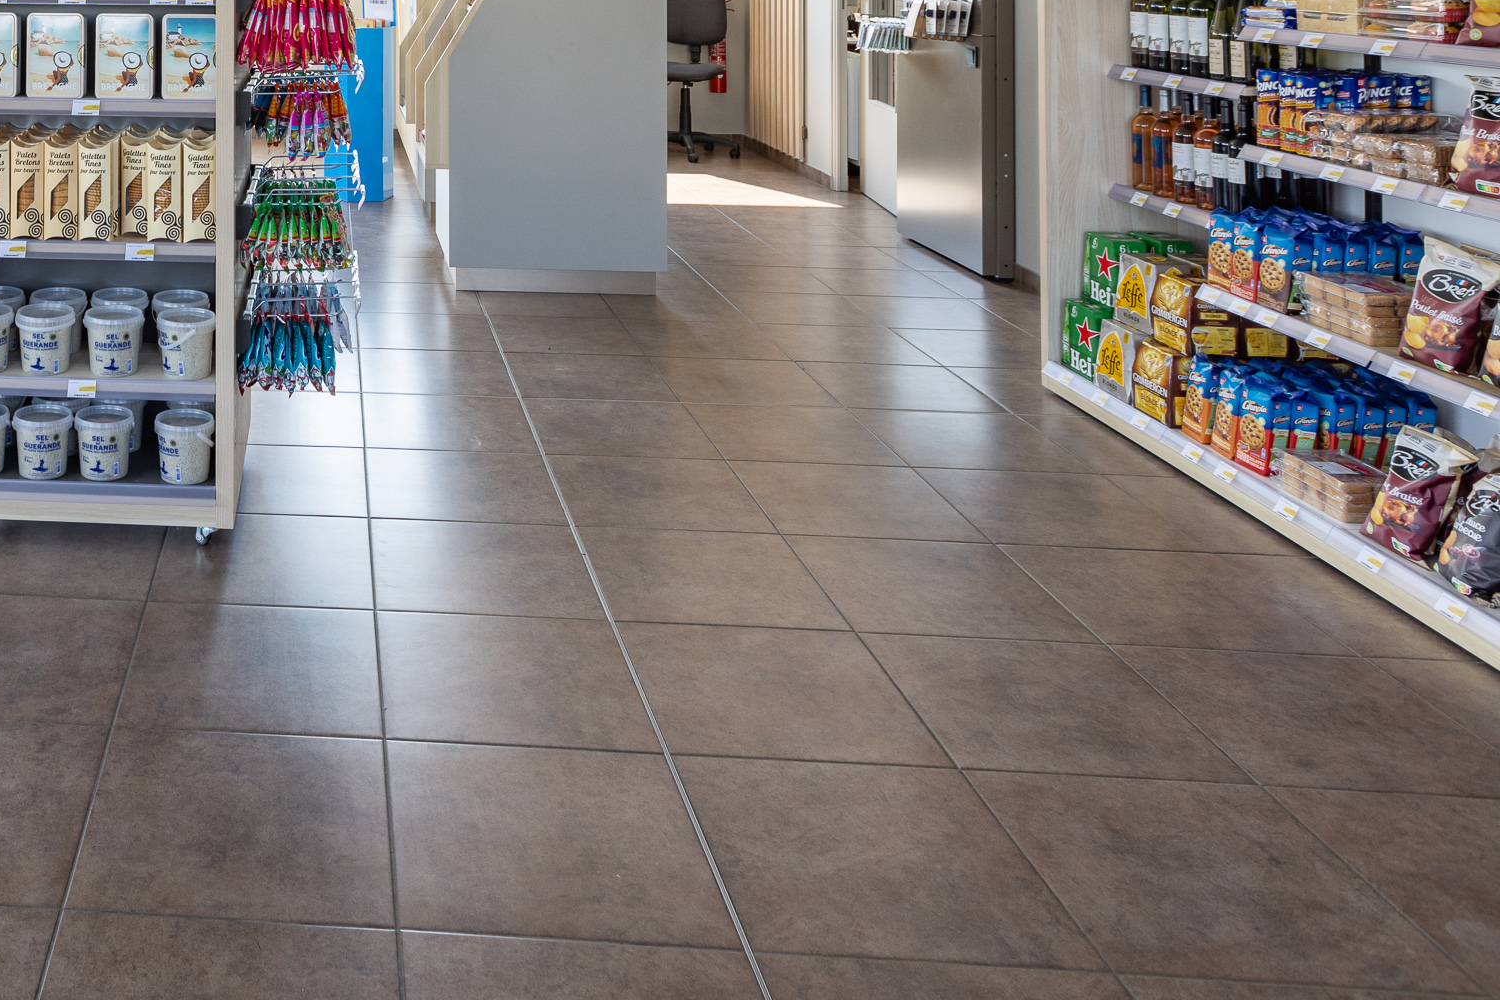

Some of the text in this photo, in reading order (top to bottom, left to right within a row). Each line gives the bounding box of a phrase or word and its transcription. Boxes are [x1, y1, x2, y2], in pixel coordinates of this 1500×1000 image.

[1256, 80, 1279, 93] PRINC
[16, 151, 37, 159] Palets
[80, 152, 106, 160] Galettes
[123, 149, 146, 158] Galettes
[150, 153, 176, 162] Galettes
[188, 154, 214, 162] Galettes
[15, 158, 41, 166] Bretons
[48, 159, 74, 167] Bretons
[126, 156, 142, 164] Fines
[193, 161, 210, 169] Fines
[1262, 244, 1288, 255] Granola
[1120, 281, 1143, 308] Leffe
[1410, 299, 1438, 317] Poulet
[1151, 306, 1188, 328] GRIMBERGEN
[1160, 324, 1179, 339] BLONDE
[23, 340, 58, 348] GUERANDE
[94, 340, 131, 349] GUERANDE
[1101, 347, 1121, 375] Leffe
[1133, 372, 1168, 398] GRIMBERGEN
[1241, 400, 1267, 414] Granola
[24, 441, 61, 450] GUERANDE
[82, 442, 118, 451] GUERANDE
[1389, 486, 1424, 506] Braisé
[1453, 524, 1482, 542] arbecue
